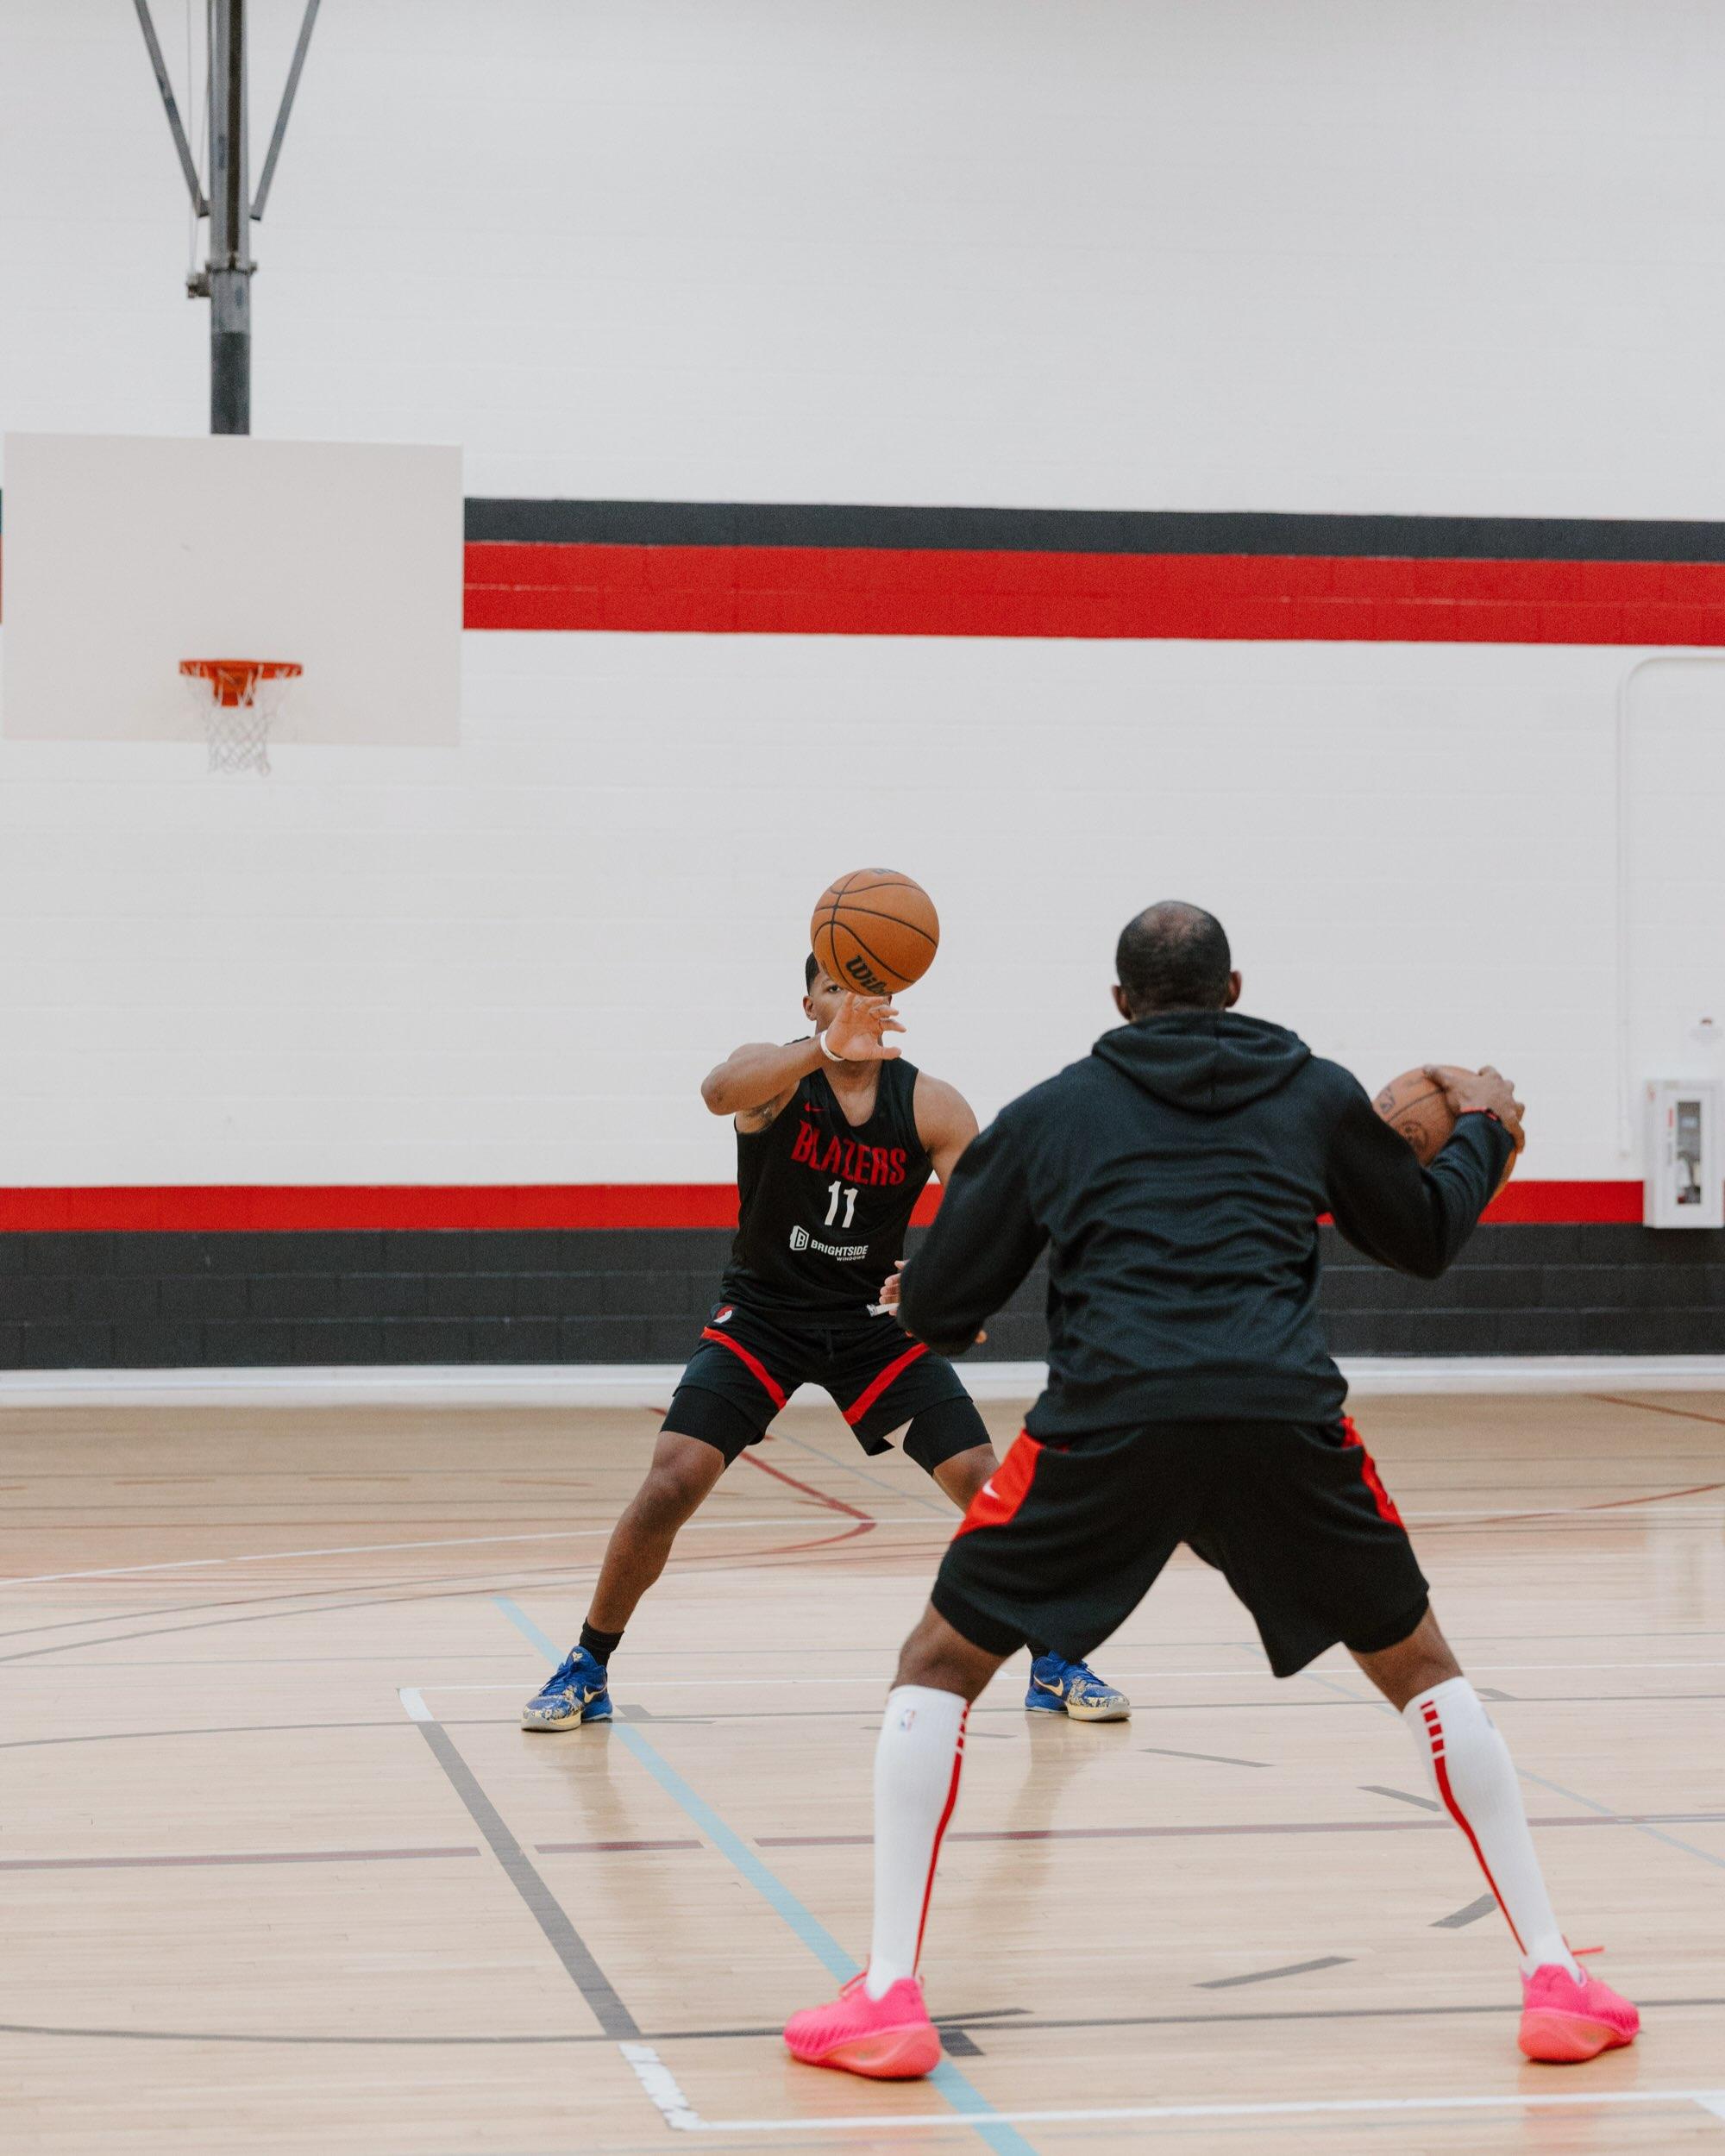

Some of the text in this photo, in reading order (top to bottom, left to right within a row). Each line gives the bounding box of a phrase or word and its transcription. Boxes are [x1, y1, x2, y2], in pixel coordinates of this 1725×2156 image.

[791, 1120, 906, 1185] BLAZERS
[825, 1181, 858, 1228] 11
[811, 1239, 869, 1257] BRIGHTSIDE
